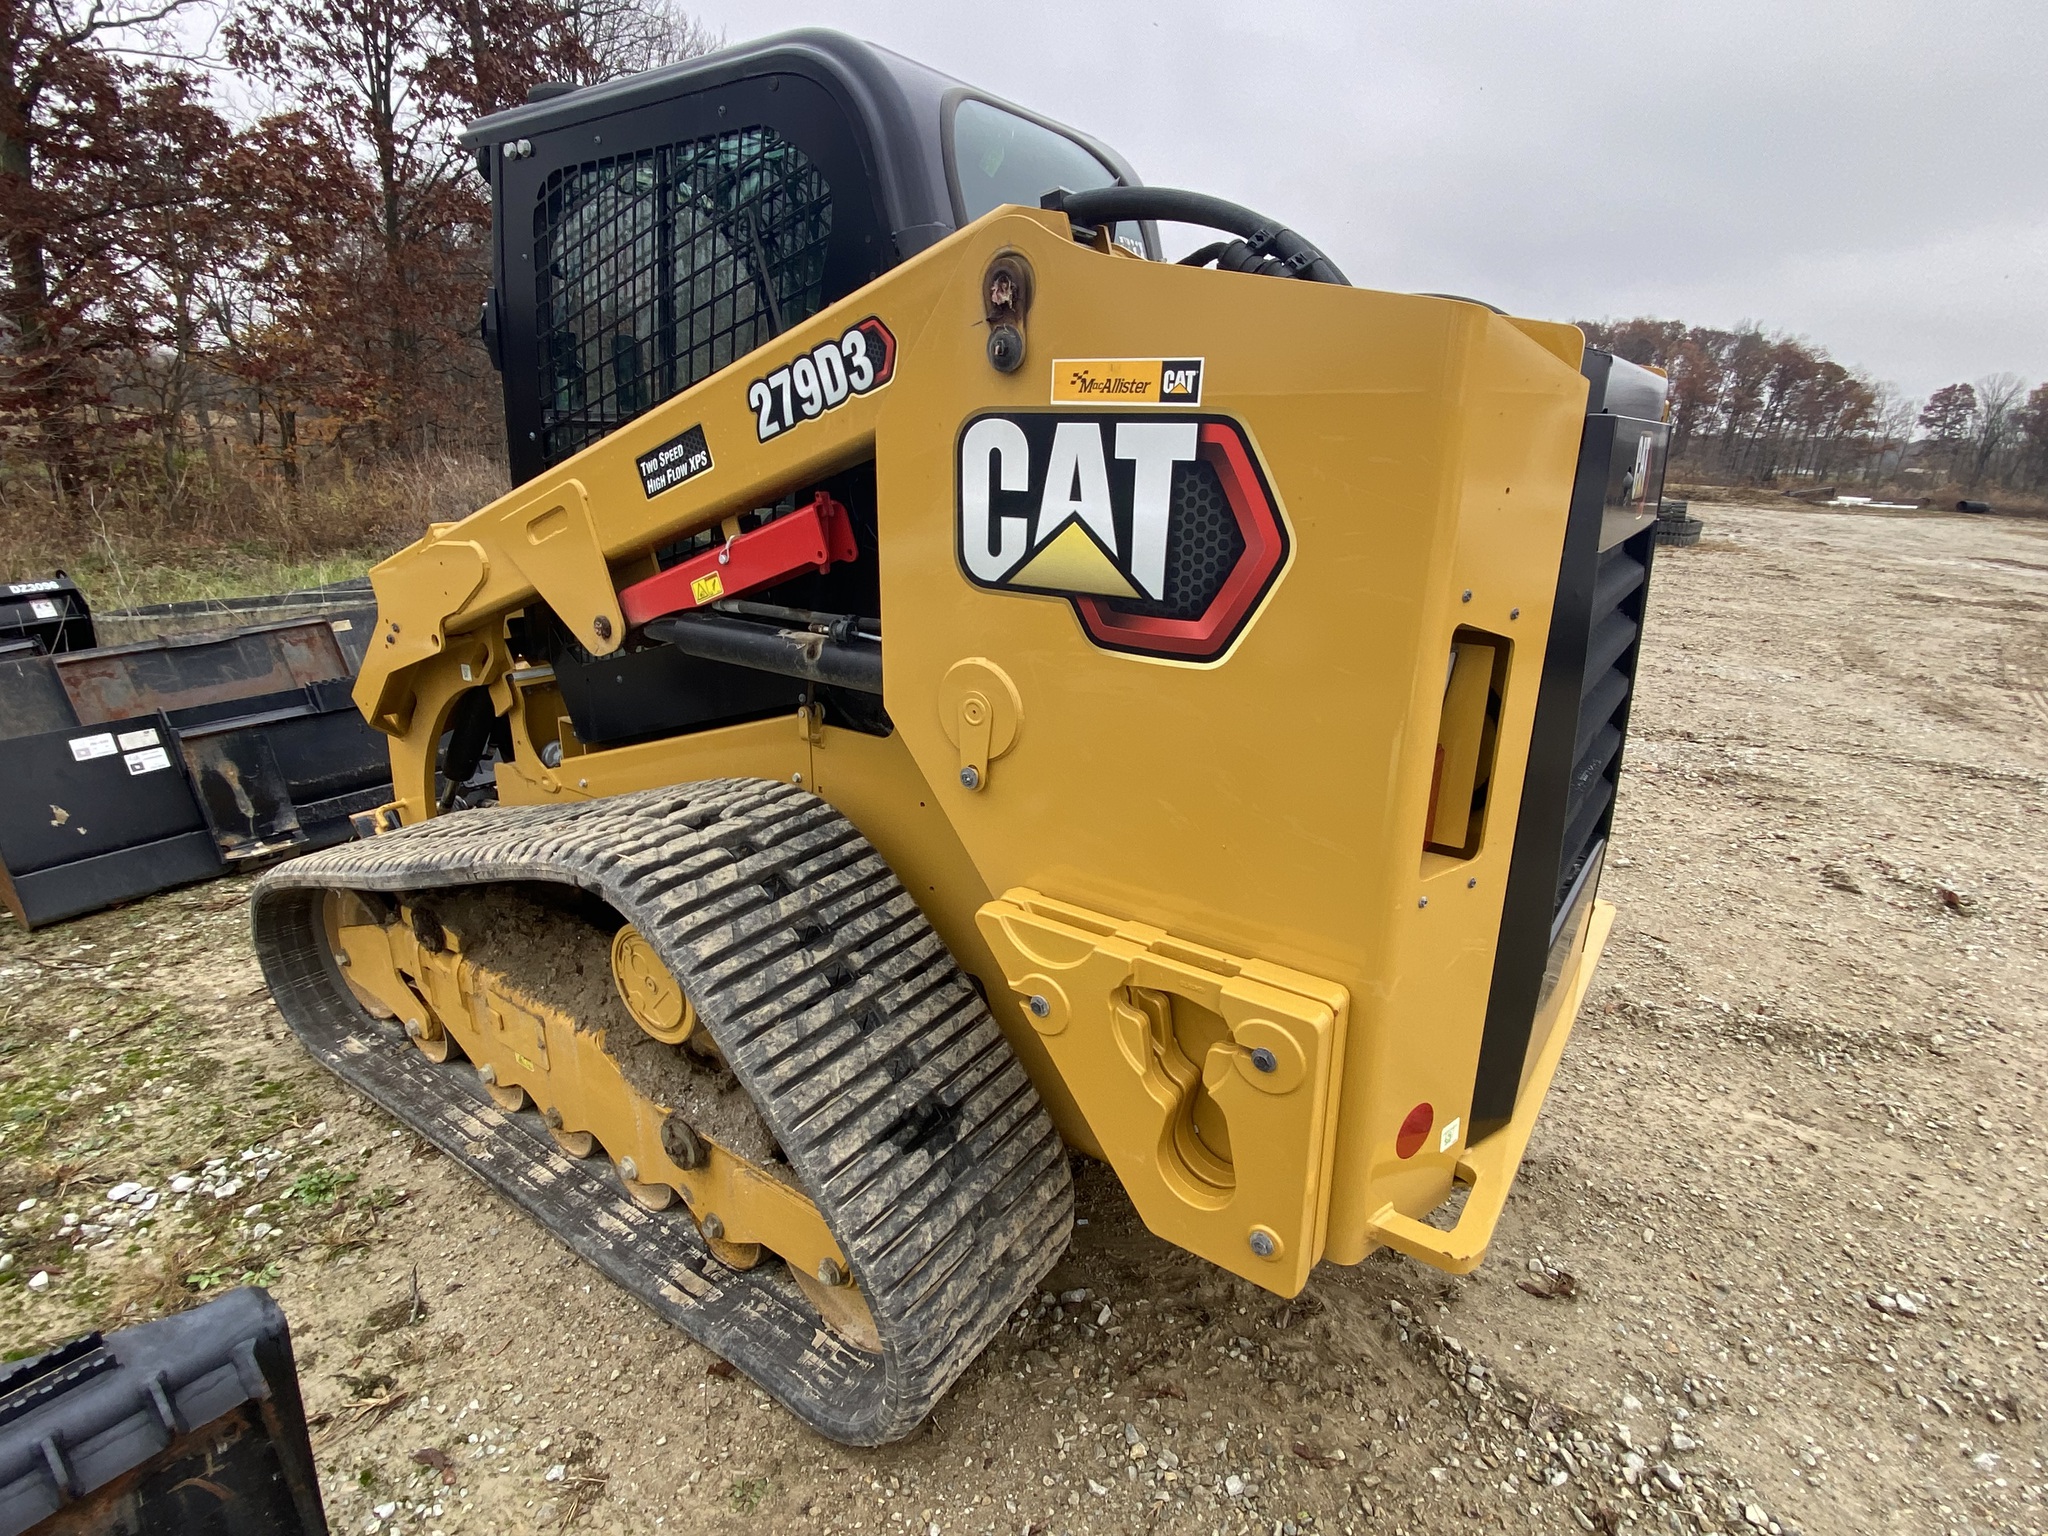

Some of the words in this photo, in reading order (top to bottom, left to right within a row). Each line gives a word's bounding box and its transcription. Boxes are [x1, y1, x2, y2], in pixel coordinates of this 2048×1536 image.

[749, 330, 875, 440] 279D3
[1078, 377, 1152, 394] MacAllister
[1163, 369, 1197, 394] CAT
[688, 450, 708, 473] XPS
[962, 418, 1199, 601] CAT
